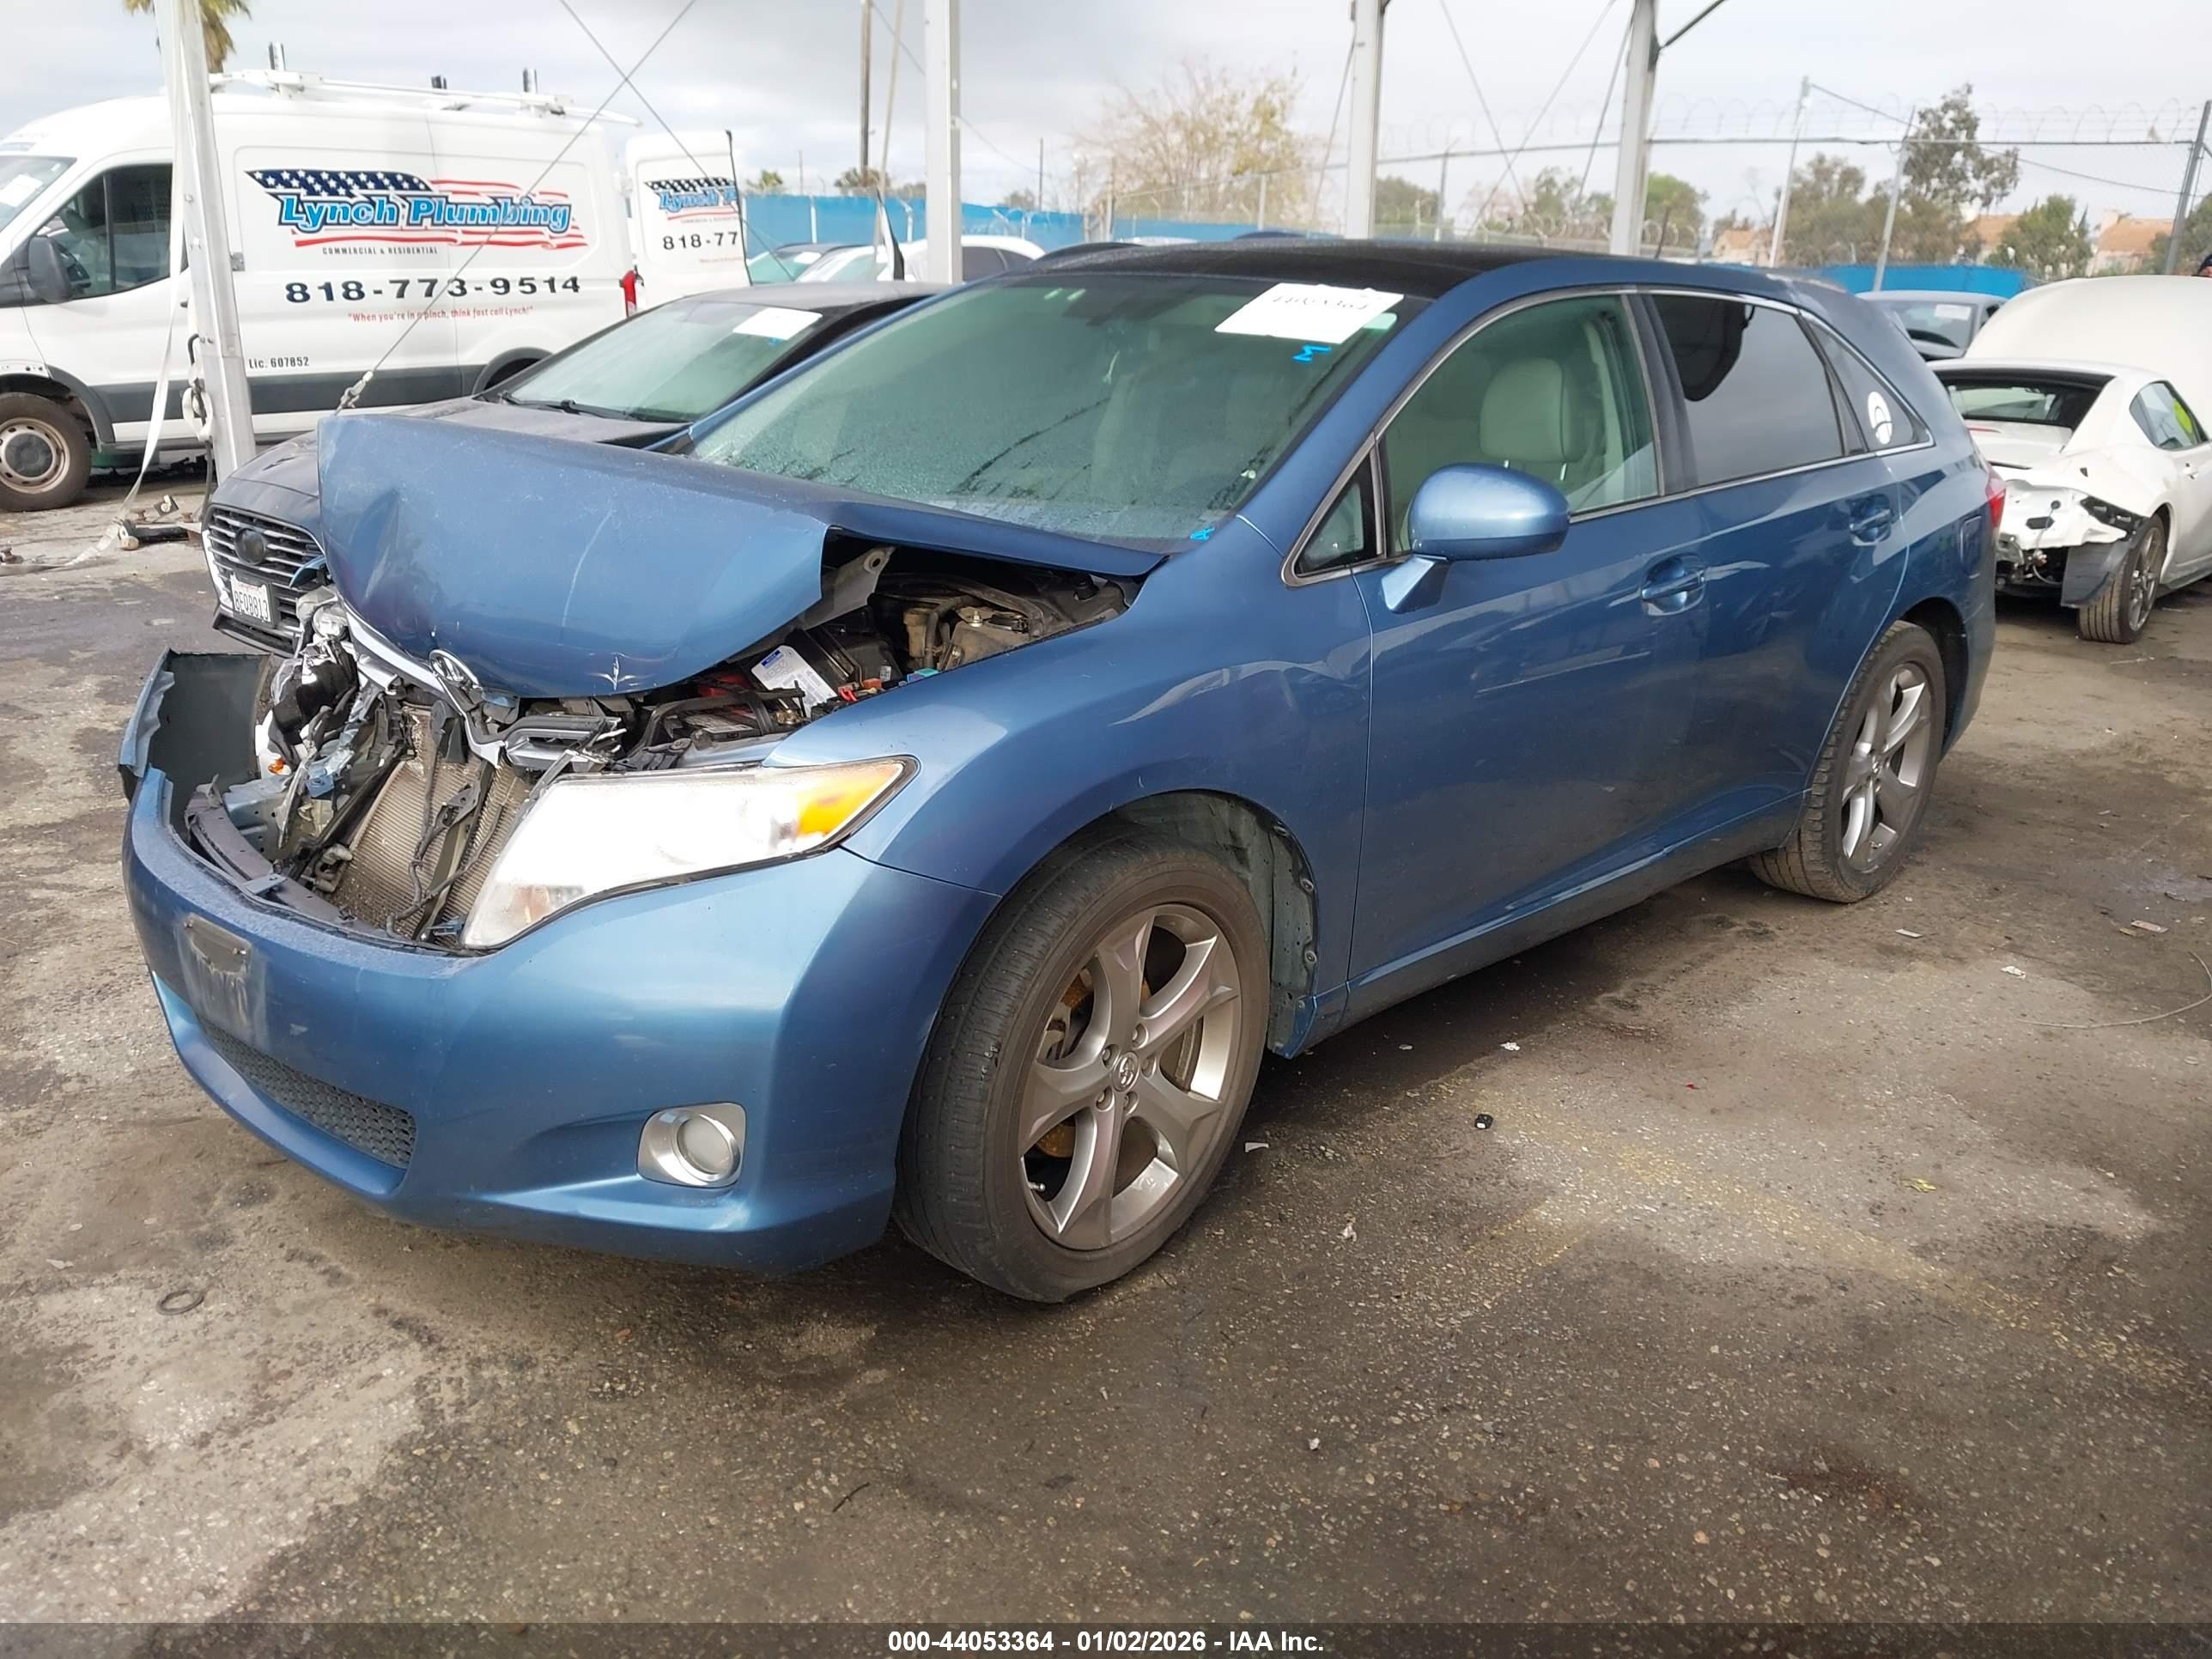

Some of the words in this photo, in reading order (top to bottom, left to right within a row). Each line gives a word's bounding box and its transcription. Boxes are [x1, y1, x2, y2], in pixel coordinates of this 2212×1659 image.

[276, 193, 402, 233] Lynch
[405, 193, 572, 234] Plumbing
[322, 246, 377, 255] COMMERCIAL
[388, 246, 438, 255] RESIDENTIAL
[284, 276, 581, 304] 818-773-9514
[270, 356, 310, 368] 607852
